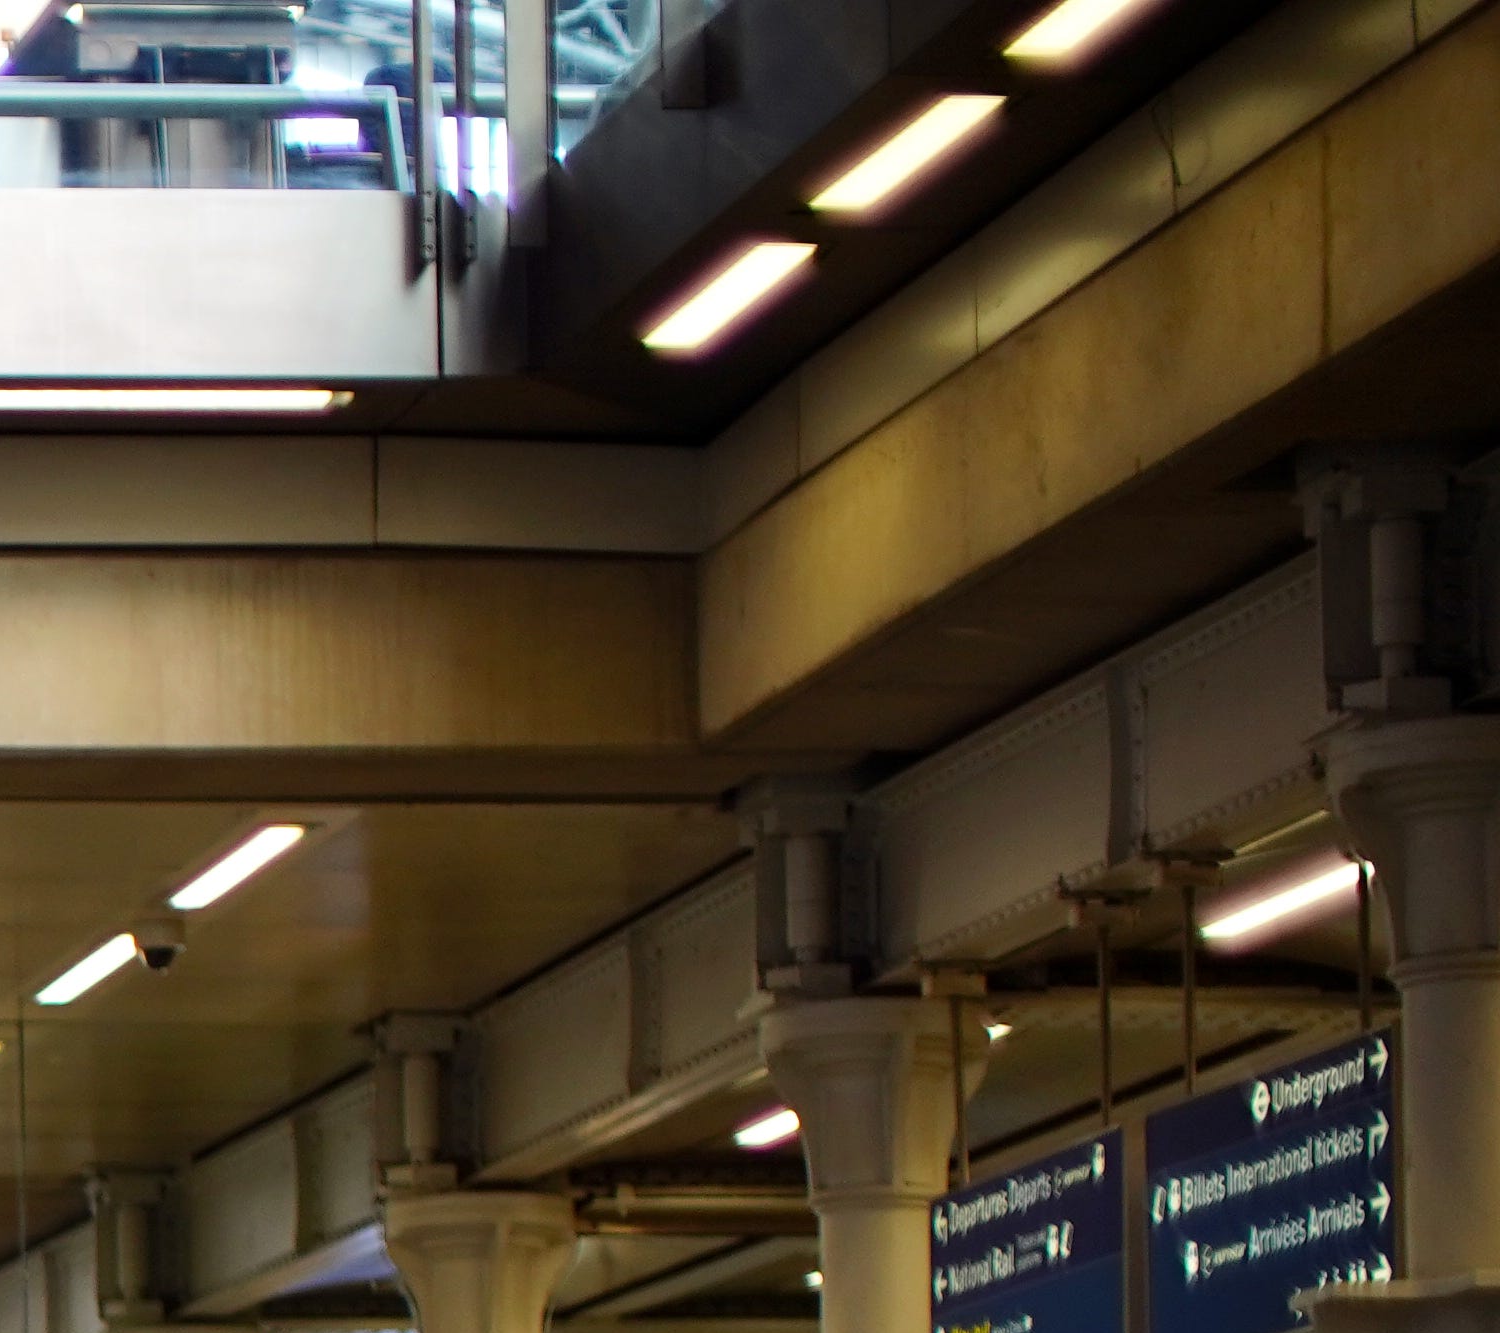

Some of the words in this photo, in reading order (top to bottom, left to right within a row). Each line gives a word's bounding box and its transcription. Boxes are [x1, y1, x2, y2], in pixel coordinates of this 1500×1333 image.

[1269, 1048, 1366, 1116] Underground
[1180, 1171, 1227, 1215] Billets
[1226, 1136, 1314, 1197] International
[1314, 1124, 1366, 1172] tickets
[947, 1189, 1009, 1240] Departures
[1007, 1171, 1052, 1217] Départs
[1247, 1212, 1308, 1263] Arrivées
[1307, 1191, 1366, 1243] Arrivals
[947, 1251, 992, 1297] National
